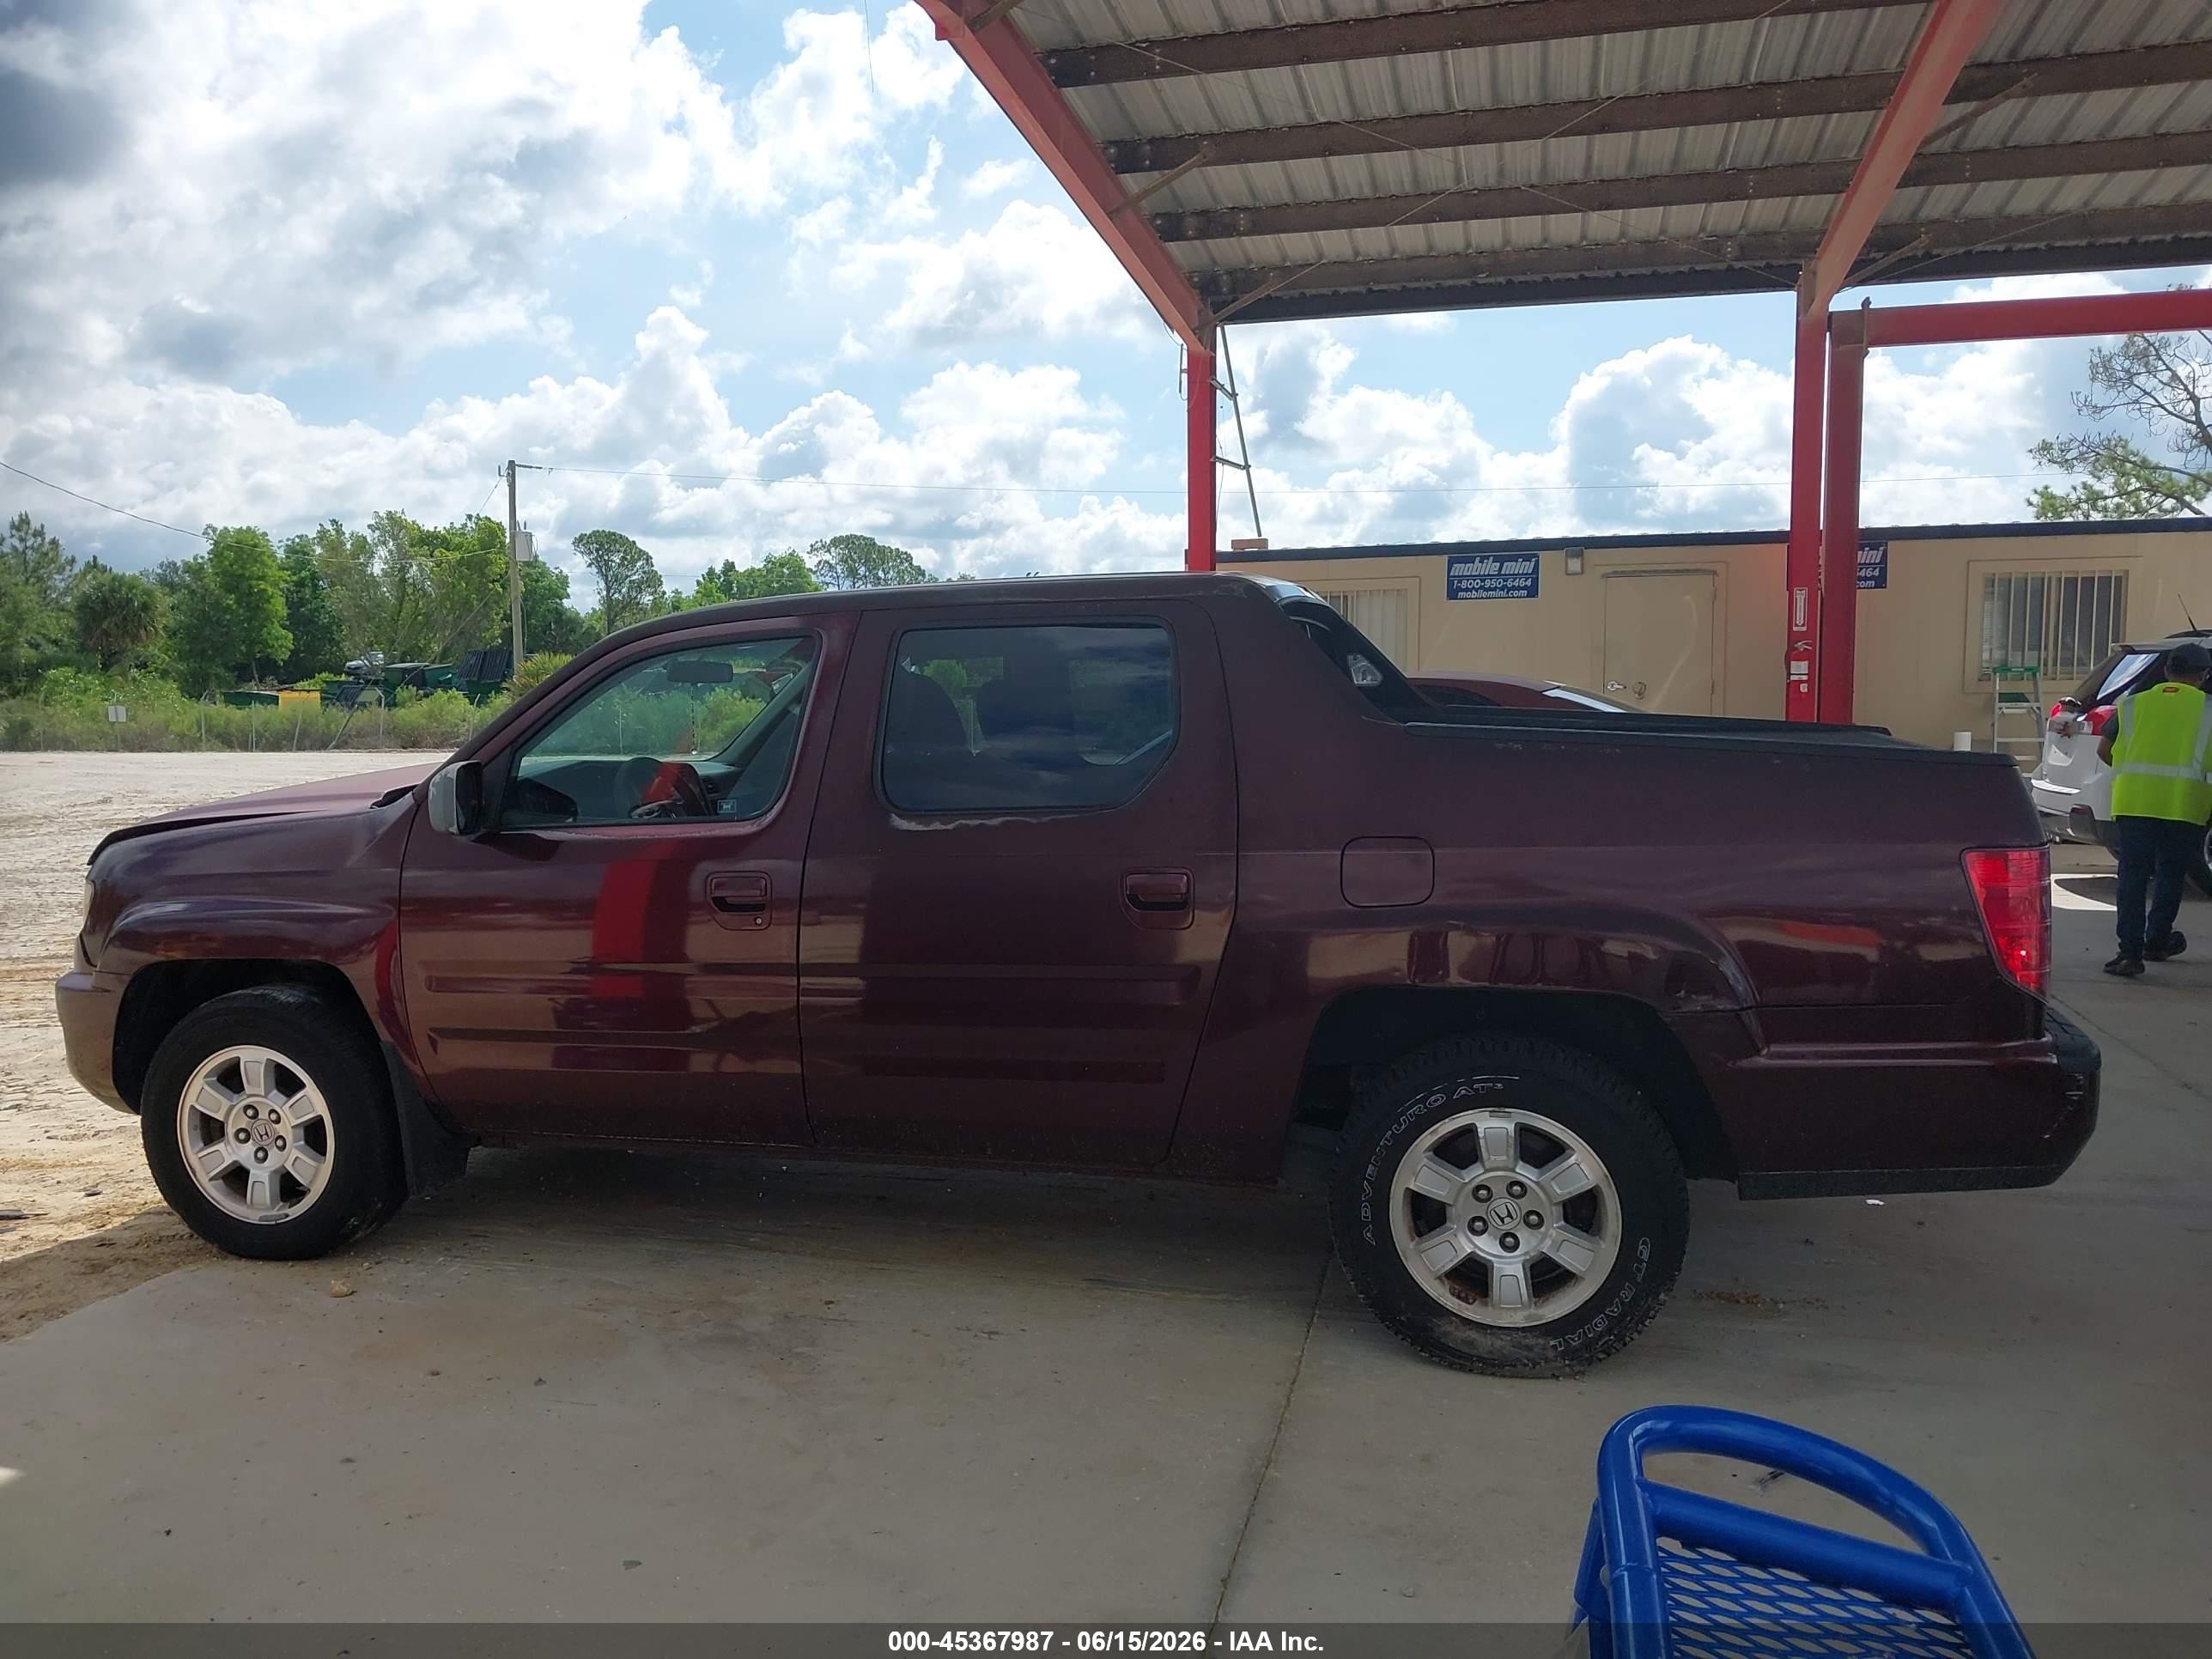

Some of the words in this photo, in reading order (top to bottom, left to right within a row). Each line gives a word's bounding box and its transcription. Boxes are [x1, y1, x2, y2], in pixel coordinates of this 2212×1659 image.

[1449, 556, 1500, 576] mobile
[1501, 558, 1536, 574] mini
[1453, 578, 1532, 589] 1-800-950-6464
[1457, 589, 1528, 599] mobilemini.com
[1361, 1094, 1446, 1245] ADVENTURO
[1633, 1237, 1650, 1283] GT
[1549, 1282, 1636, 1351] RADIAL
